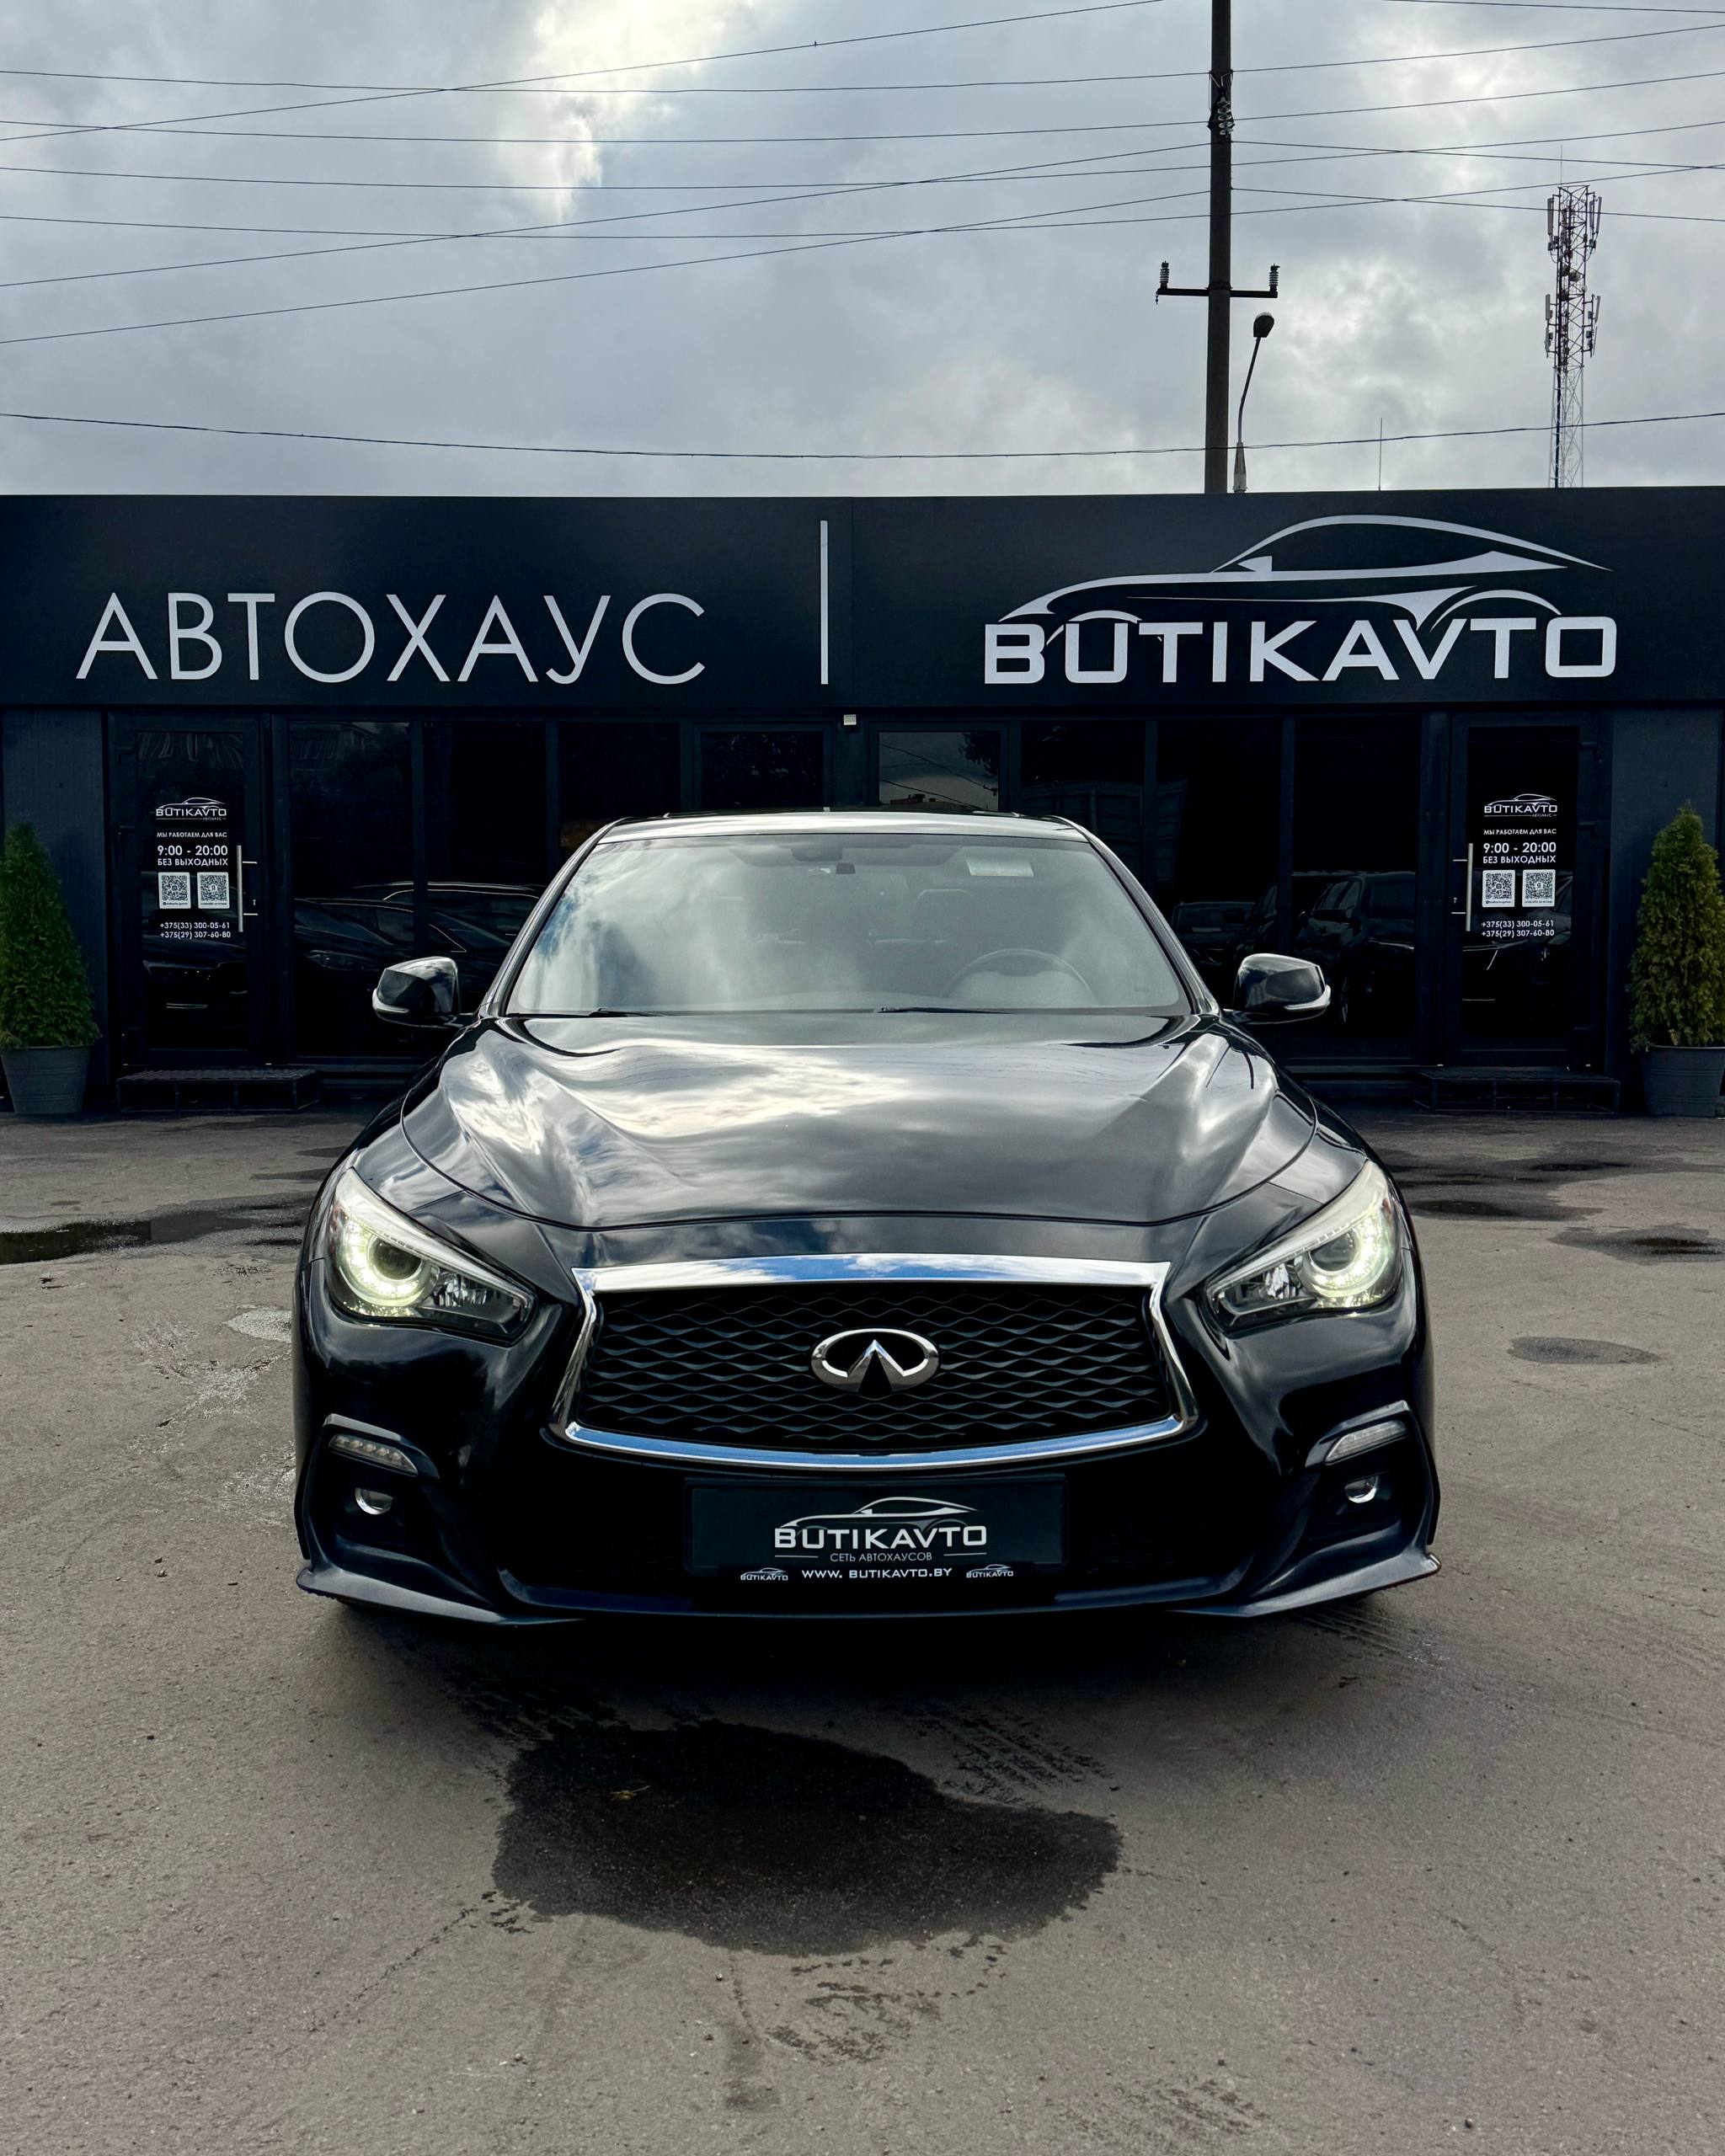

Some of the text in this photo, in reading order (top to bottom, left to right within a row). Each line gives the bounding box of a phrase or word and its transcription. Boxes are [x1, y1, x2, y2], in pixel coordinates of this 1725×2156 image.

[76, 591, 706, 685] АВТОХАУС
[984, 616, 1616, 684] BUTIKAVTO
[1484, 804, 1557, 813] BUTIKAVTO
[158, 845, 183, 856] 9:00
[195, 845, 228, 856] 20:00
[1483, 842, 1509, 853] 9:00
[1522, 842, 1557, 852] 20:00
[174, 858, 228, 867] ВЫХОДНЫХ
[1500, 855, 1557, 864] ВЫХОДНЫХ
[1482, 921, 1514, 929] +375(33)
[160, 931, 193, 939] +375(29)
[1482, 930, 1514, 938] +375(29)
[774, 1525, 986, 1550] BUTIKAVTO
[830, 1552, 932, 1562] СЕТЬ АВТОХАУСОВ
[849, 1568, 952, 1578] BUTIKAVTO.BY
